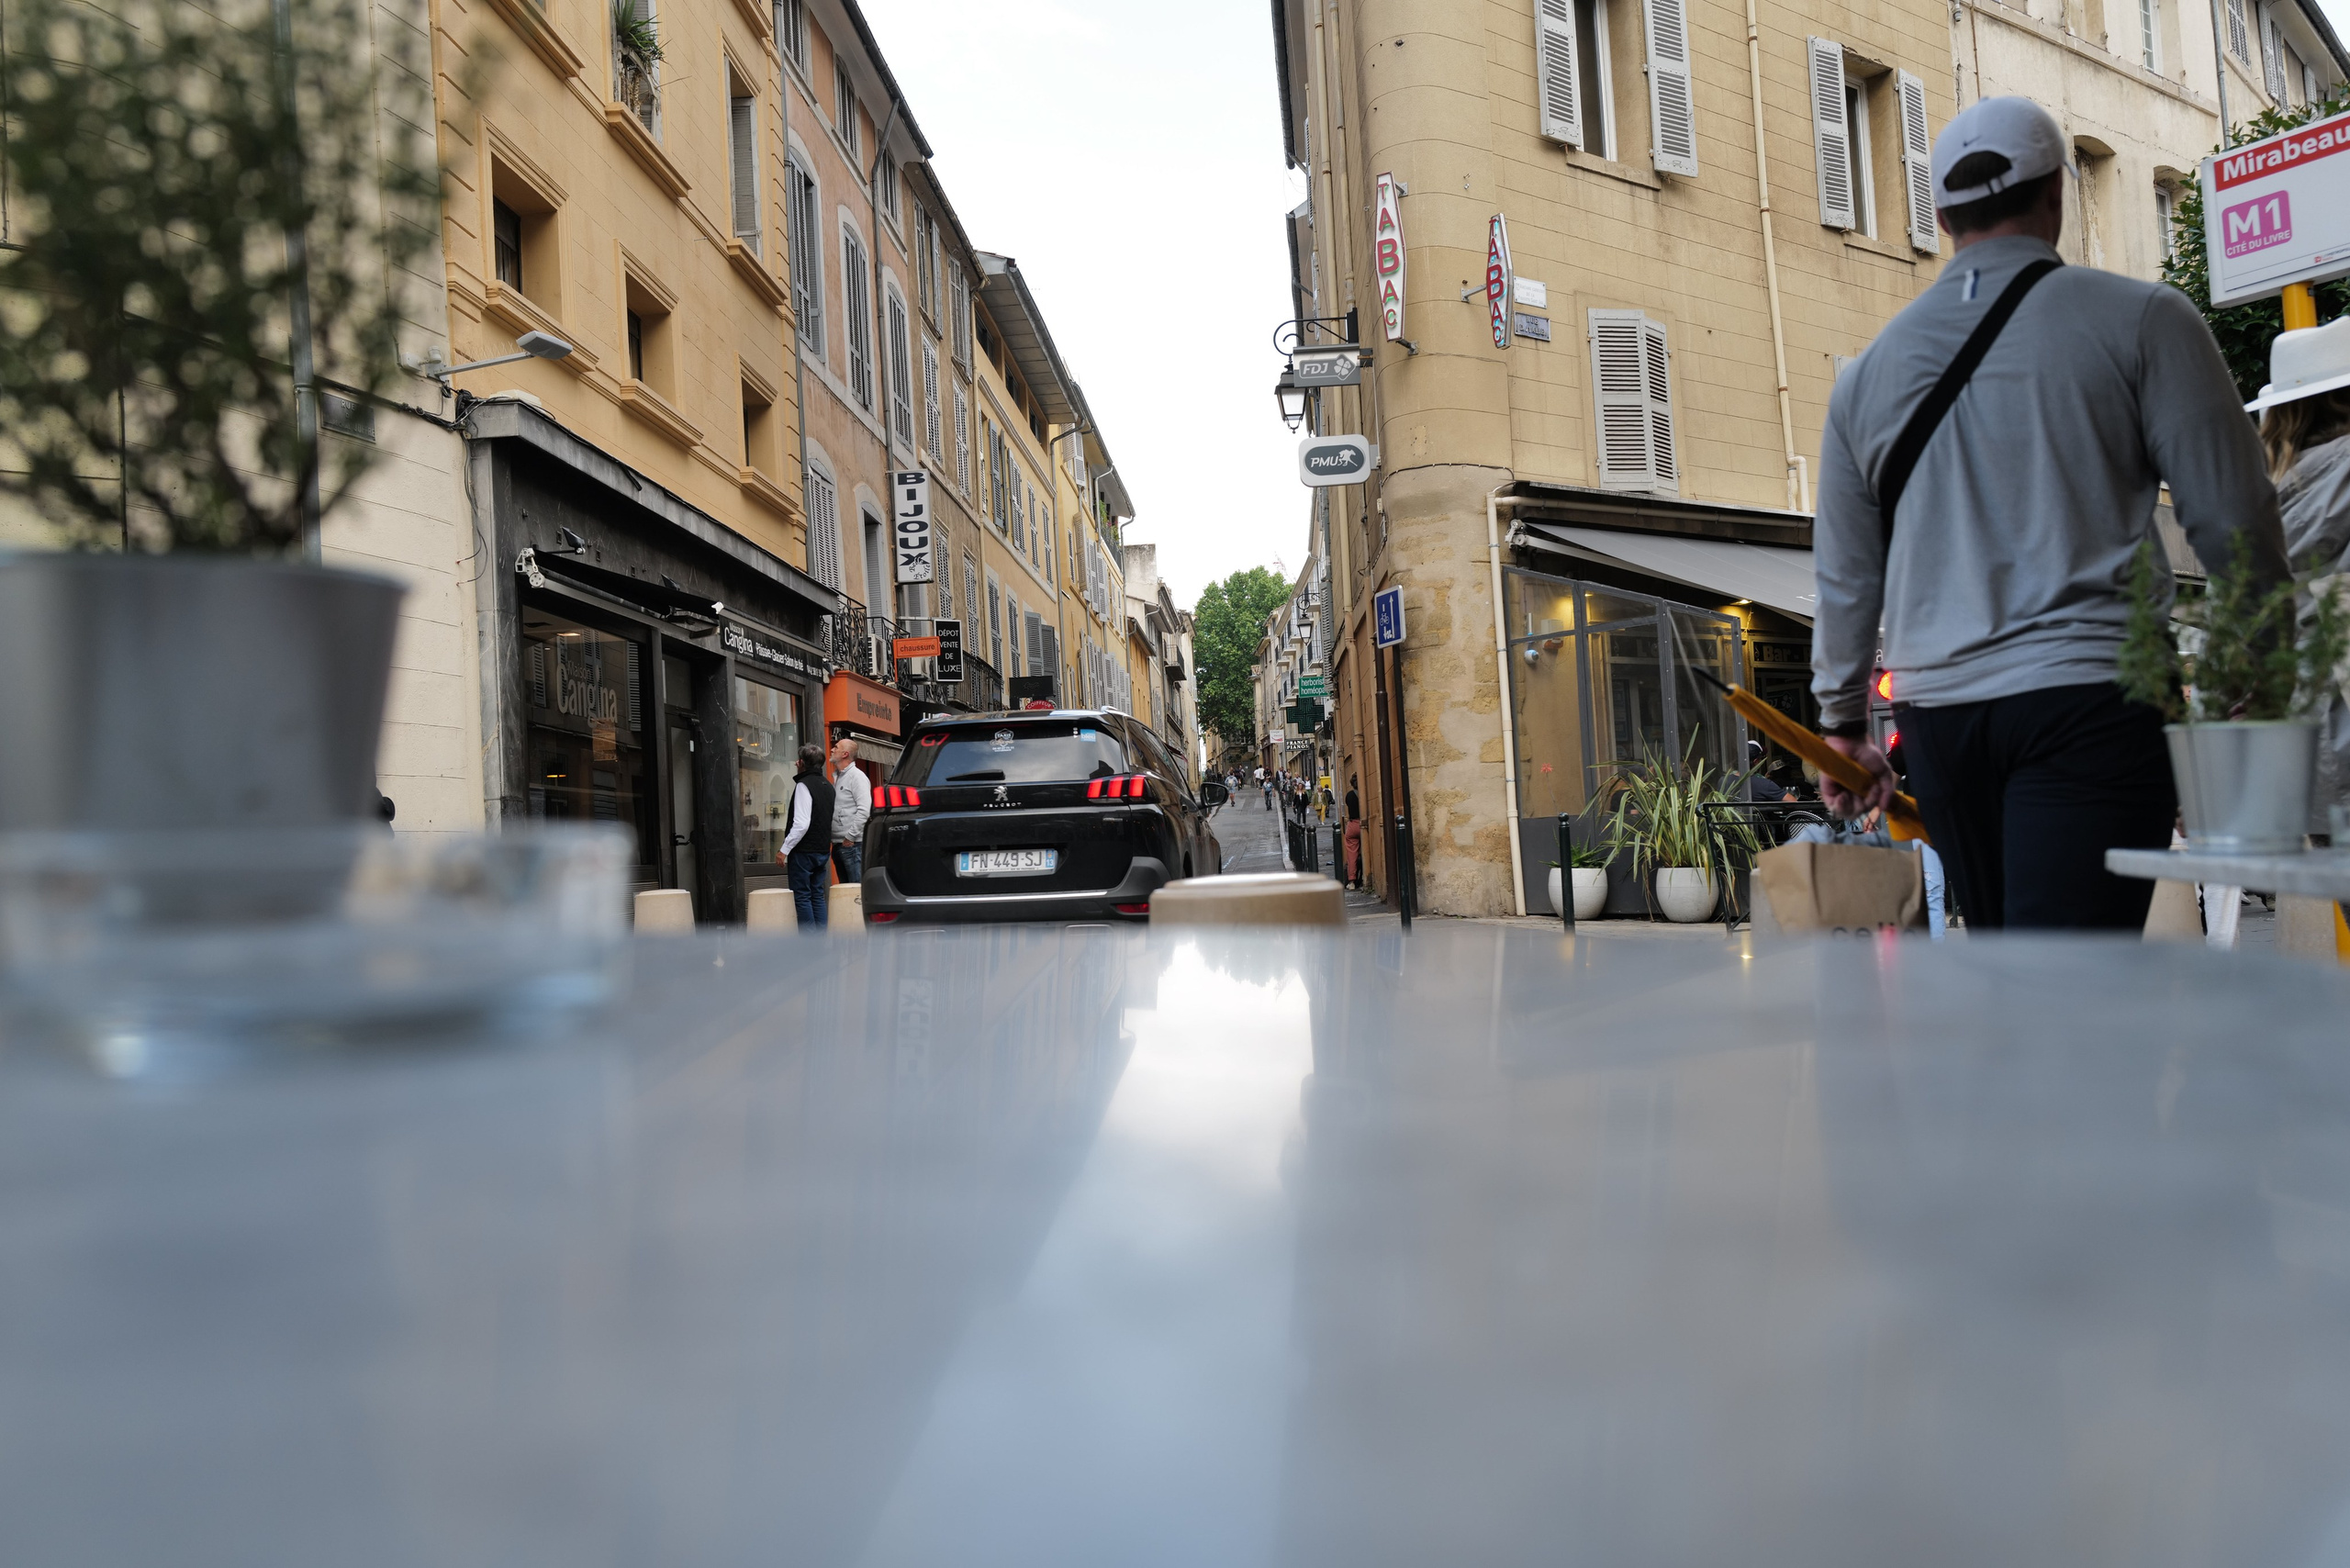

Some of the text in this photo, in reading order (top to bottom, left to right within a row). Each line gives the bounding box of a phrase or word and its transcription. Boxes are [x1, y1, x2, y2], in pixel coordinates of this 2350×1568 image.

[2223, 125, 2350, 182] Mirabeau
[2228, 197, 2282, 243] M1
[2226, 230, 2291, 256] CITÉ DU LIVRE
[1377, 183, 1400, 327] TABAC
[1486, 218, 1505, 343] TABAC
[1526, 315, 1539, 326] RUE
[1304, 363, 1328, 375] FDJ
[341, 399, 355, 410] RUE
[1311, 456, 1339, 467] PMU
[898, 473, 930, 566] BIJOUX
[938, 629, 958, 637] DÉPOT
[724, 627, 754, 654] Cangina
[900, 644, 935, 653] chaussure
[1762, 644, 1790, 662] Bar
[938, 665, 962, 673] LUXE
[1301, 678, 1324, 687] herborist
[1301, 687, 1325, 696] homéopa
[856, 692, 892, 722] Empreinte
[1027, 700, 1052, 710] COIFFEUR
[921, 734, 951, 747] G7
[971, 851, 1042, 868] FN-449-SJ
